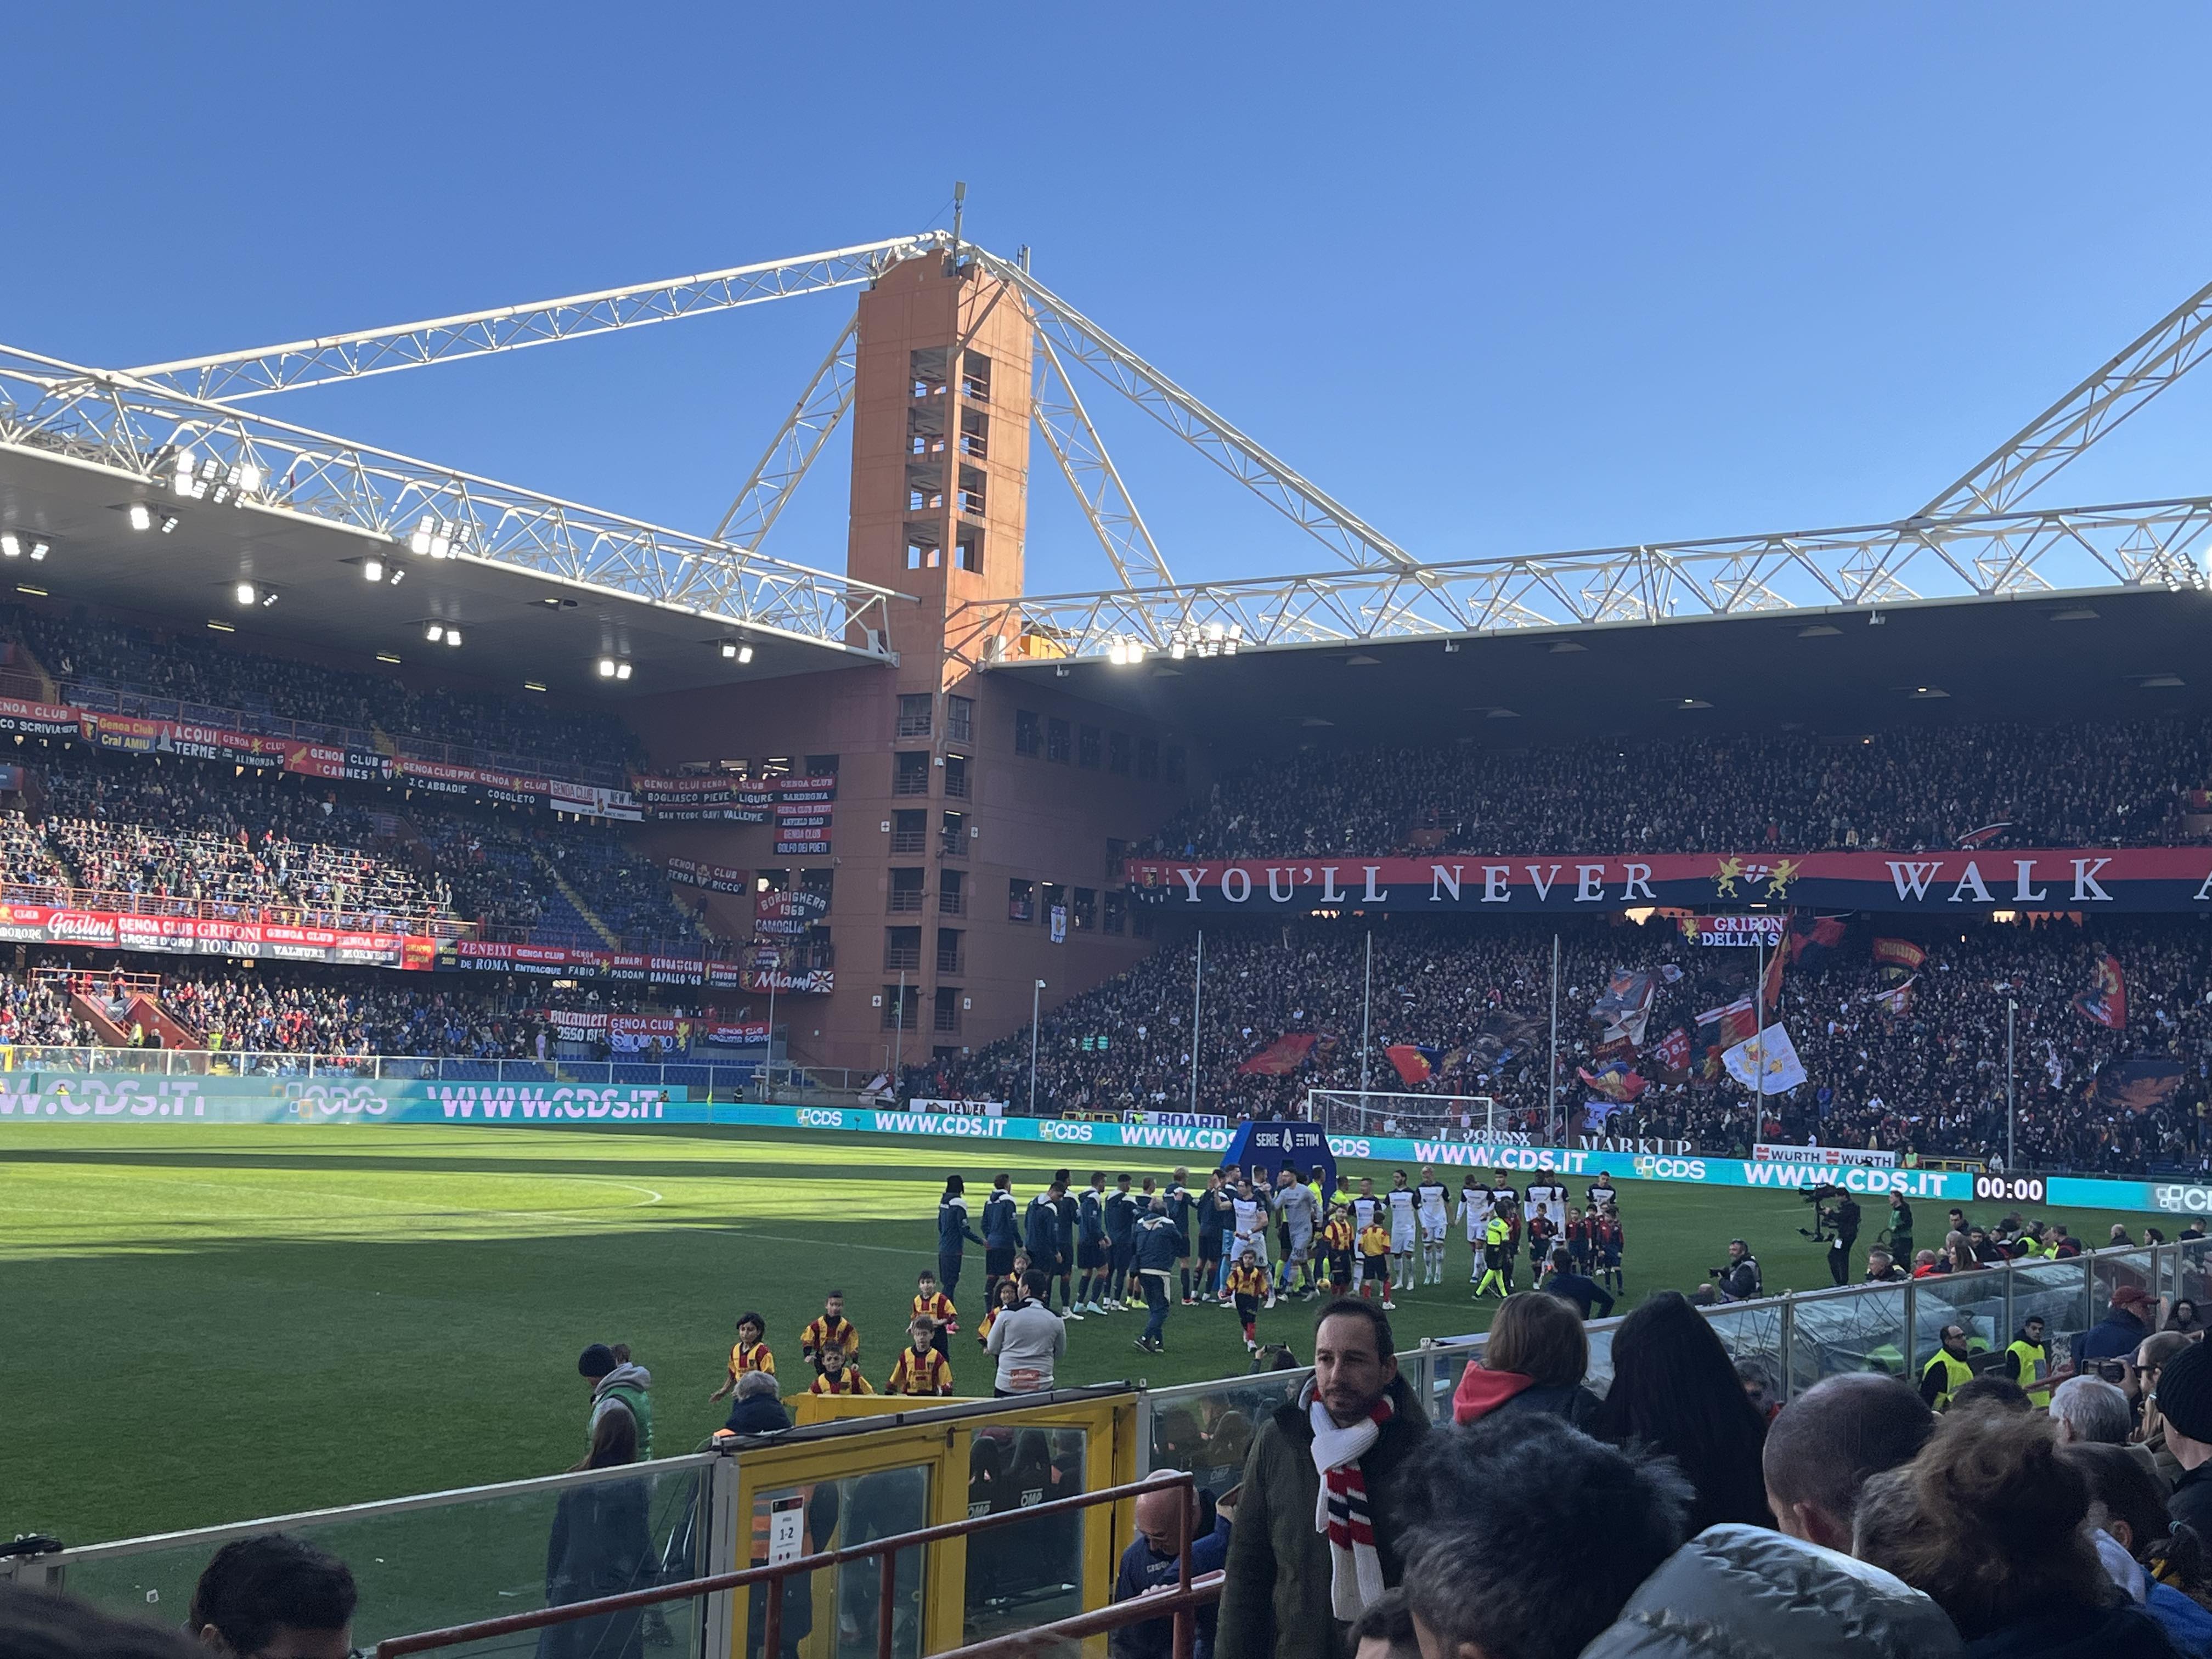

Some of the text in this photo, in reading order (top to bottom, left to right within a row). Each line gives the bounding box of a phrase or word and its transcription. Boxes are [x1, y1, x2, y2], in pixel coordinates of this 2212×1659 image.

[35, 707, 67, 719] CLUB
[19, 721, 61, 734] SCRIVIA
[99, 718, 154, 736] Genoa Club
[174, 726, 217, 742] ACQUI
[101, 733, 150, 750] Cral AMIU
[223, 735, 250, 747] GENOA
[174, 742, 217, 760] TERME
[311, 748, 379, 767] GENOA CLUB
[323, 765, 368, 780] CANNES
[403, 762, 433, 775] GENOA
[434, 767, 456, 778] CLUB
[427, 781, 468, 794] ABBADIE
[480, 774, 548, 791] GENOA CLUB
[644, 779, 674, 789] GENOA
[742, 781, 764, 789] CLUB
[781, 778, 833, 788] GENOA CLUB
[488, 789, 535, 804] COGOLETO
[552, 781, 594, 800] GENOA CLUB
[610, 791, 625, 804] NEW
[647, 792, 698, 803] BOGLIASCO
[703, 792, 774, 804] PIEVE LIGURE
[782, 792, 828, 801] SARDEGNA
[783, 829, 821, 839] GENOA CLUB
[777, 842, 827, 853] GOLFO DEI POETI
[668, 858, 737, 879] GENOA CLUB
[667, 870, 694, 884] SERRA
[1177, 858, 2114, 903] YOU'LL NEVER WALK
[760, 891, 826, 911] BORDIGHERA
[780, 904, 805, 916] 1968
[119, 917, 194, 935] GENOA CLUB
[197, 923, 263, 940] GRIFONI
[119, 933, 157, 945] CROCE
[160, 936, 193, 947] D'ORO
[266, 928, 334, 943] GENOA CLUB
[1702, 932, 1760, 947] DELLA
[199, 938, 260, 956] TORINO
[516, 948, 565, 961] GENOA CLUB
[571, 949, 594, 958] GENOA
[475, 958, 510, 972] ROMA
[582, 957, 601, 965] CLUB
[651, 957, 703, 972] GENOA CLUB
[515, 963, 562, 975] ENTRACQUE
[568, 965, 645, 980] FABIO PADOAN
[650, 972, 685, 985] RAPALLO
[755, 970, 812, 991] Miami
[611, 1018, 674, 1030] GENOA CLUB
[810, 1110, 842, 1127] CDS
[875, 1112, 1008, 1137] WWW.CDS.IT
[1054, 1122, 1093, 1141] CDS
[1256, 1132, 1279, 1148] SERIE
[1304, 1132, 1320, 1147] TIM
[1328, 1137, 1370, 1158] CDS
[1413, 1142, 1589, 1173] WWW.CDS.IT
[1655, 1158, 1706, 1180] CDS
[1743, 1162, 1948, 1197] WWW.CDS.IT
[1976, 1176, 2044, 1201] 00:00
[1020, 1492, 1042, 1507] OMP
[780, 1527, 794, 1541] 1-2
